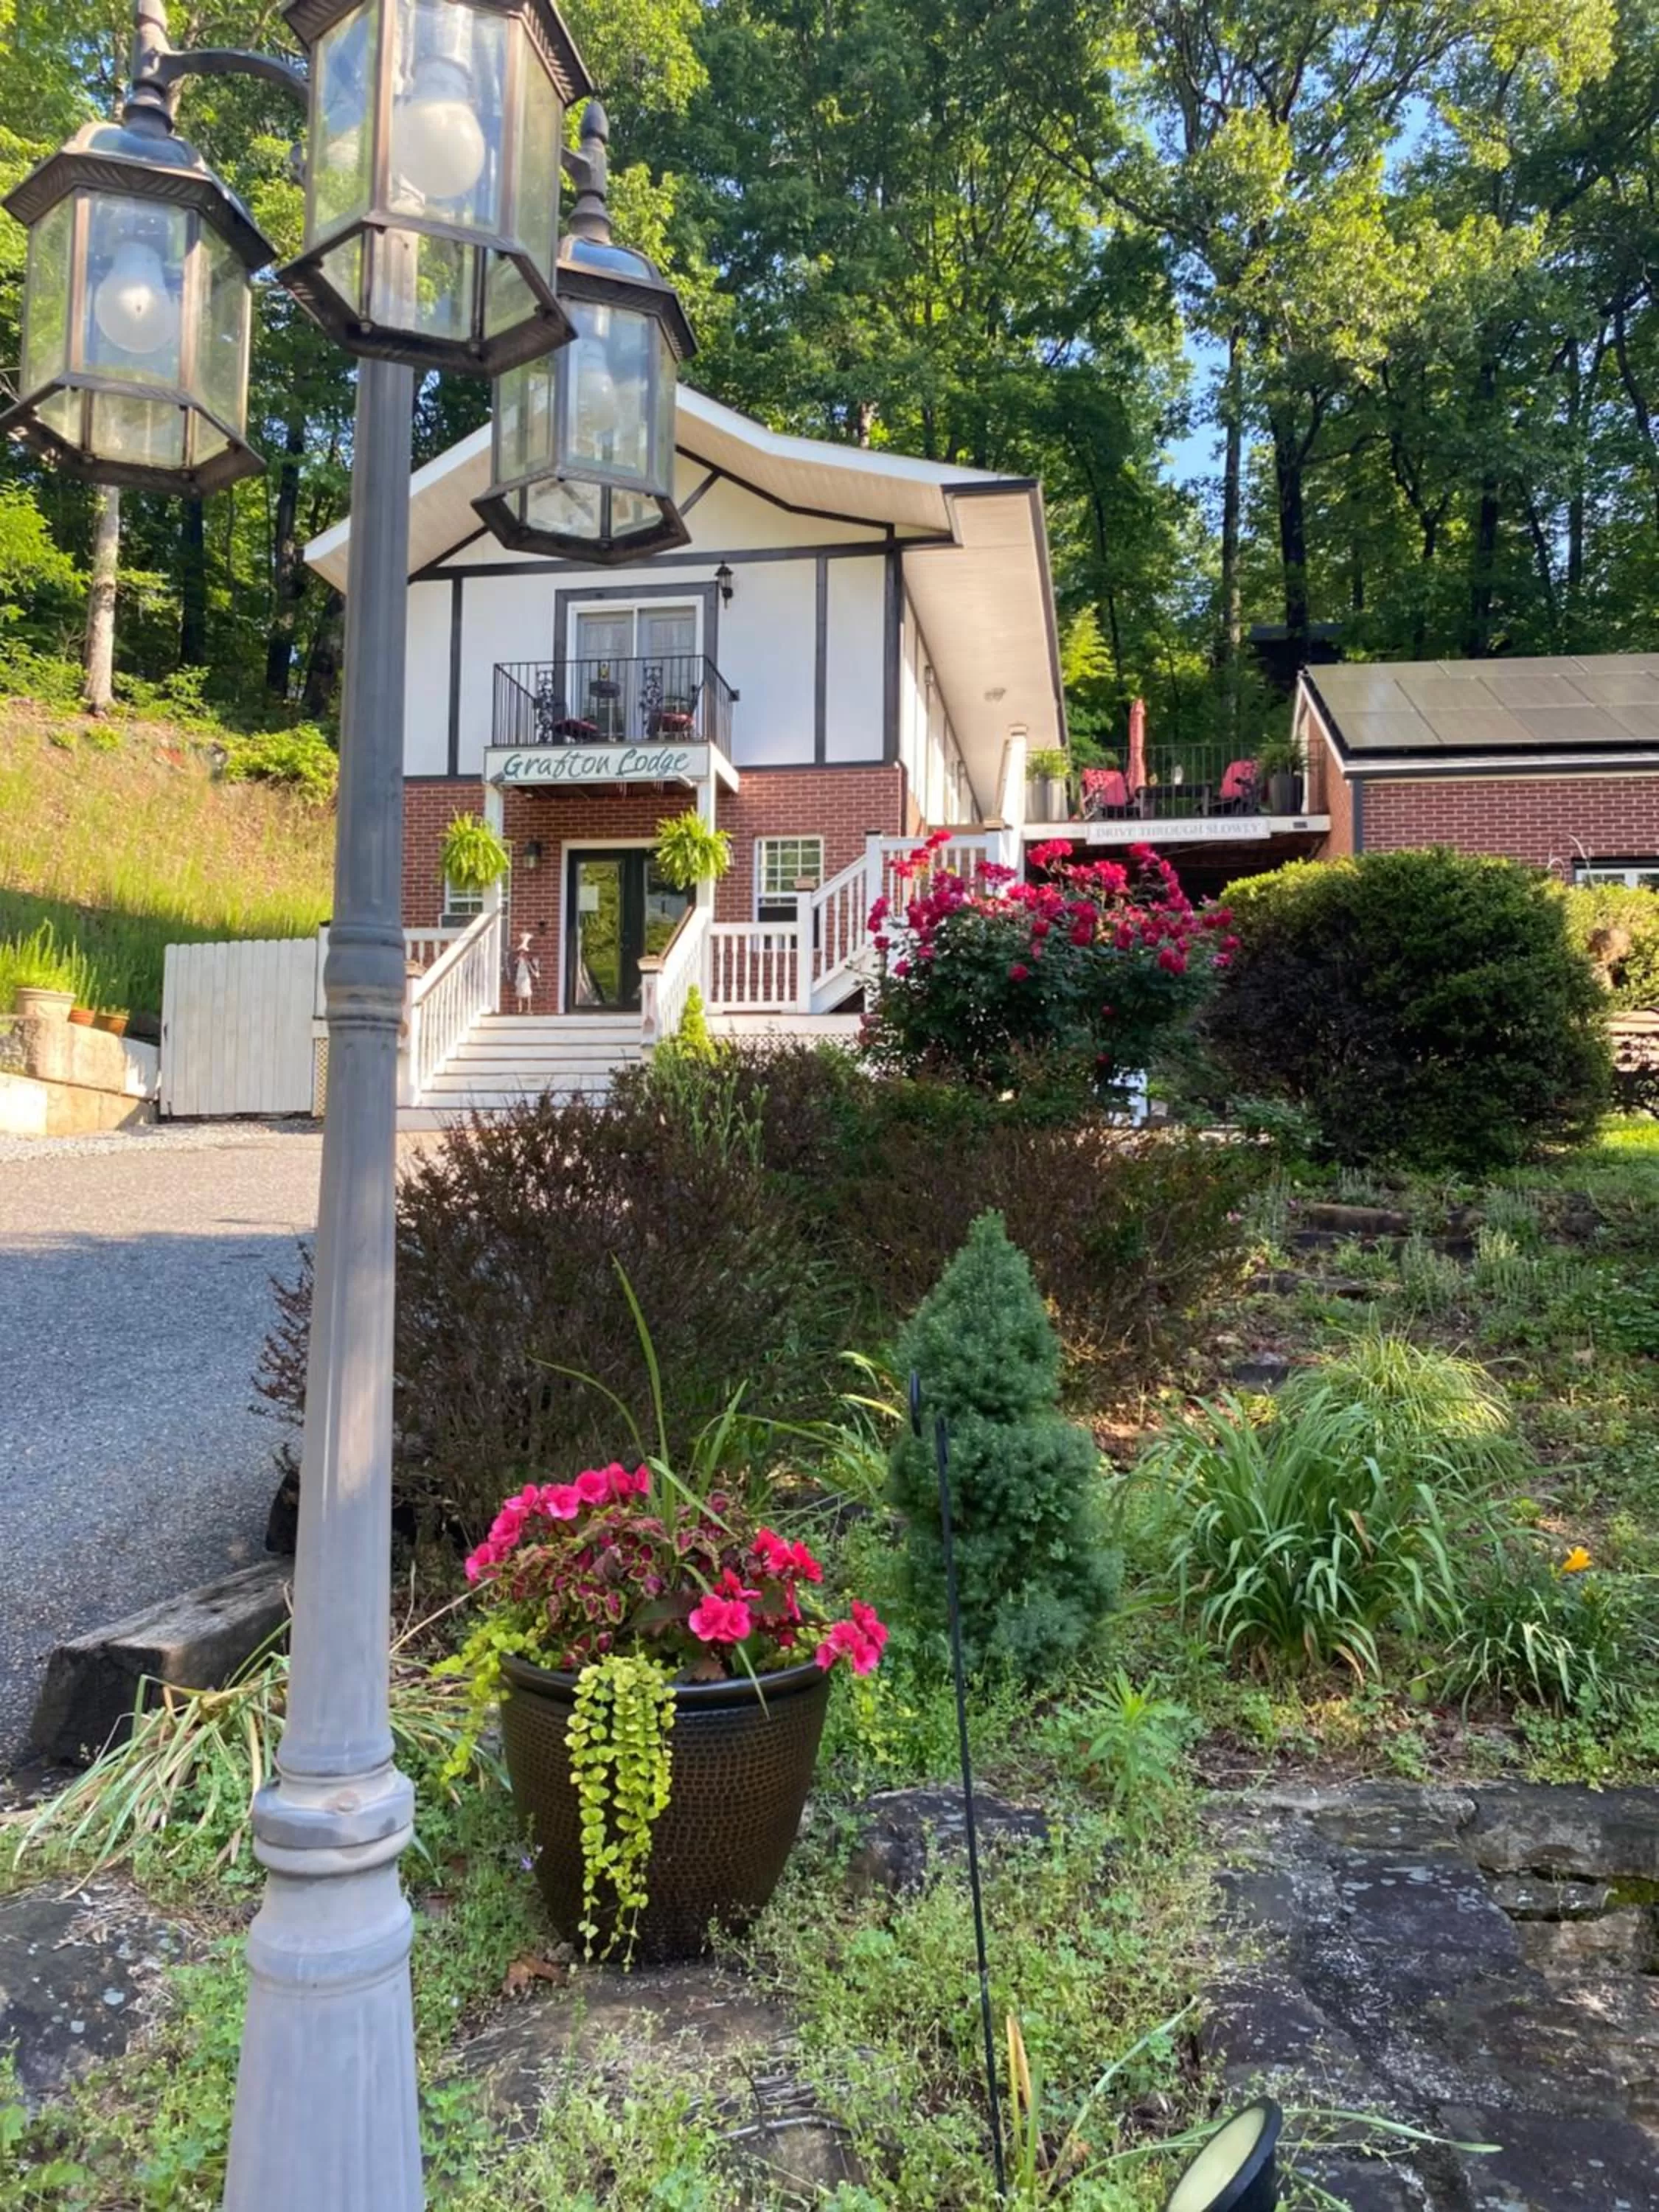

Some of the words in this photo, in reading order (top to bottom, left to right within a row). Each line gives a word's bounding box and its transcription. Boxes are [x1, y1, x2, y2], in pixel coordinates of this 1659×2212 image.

[503, 751, 611, 779] Grafton
[616, 747, 690, 774] Lodge
[1096, 827, 1134, 838] DRIVE
